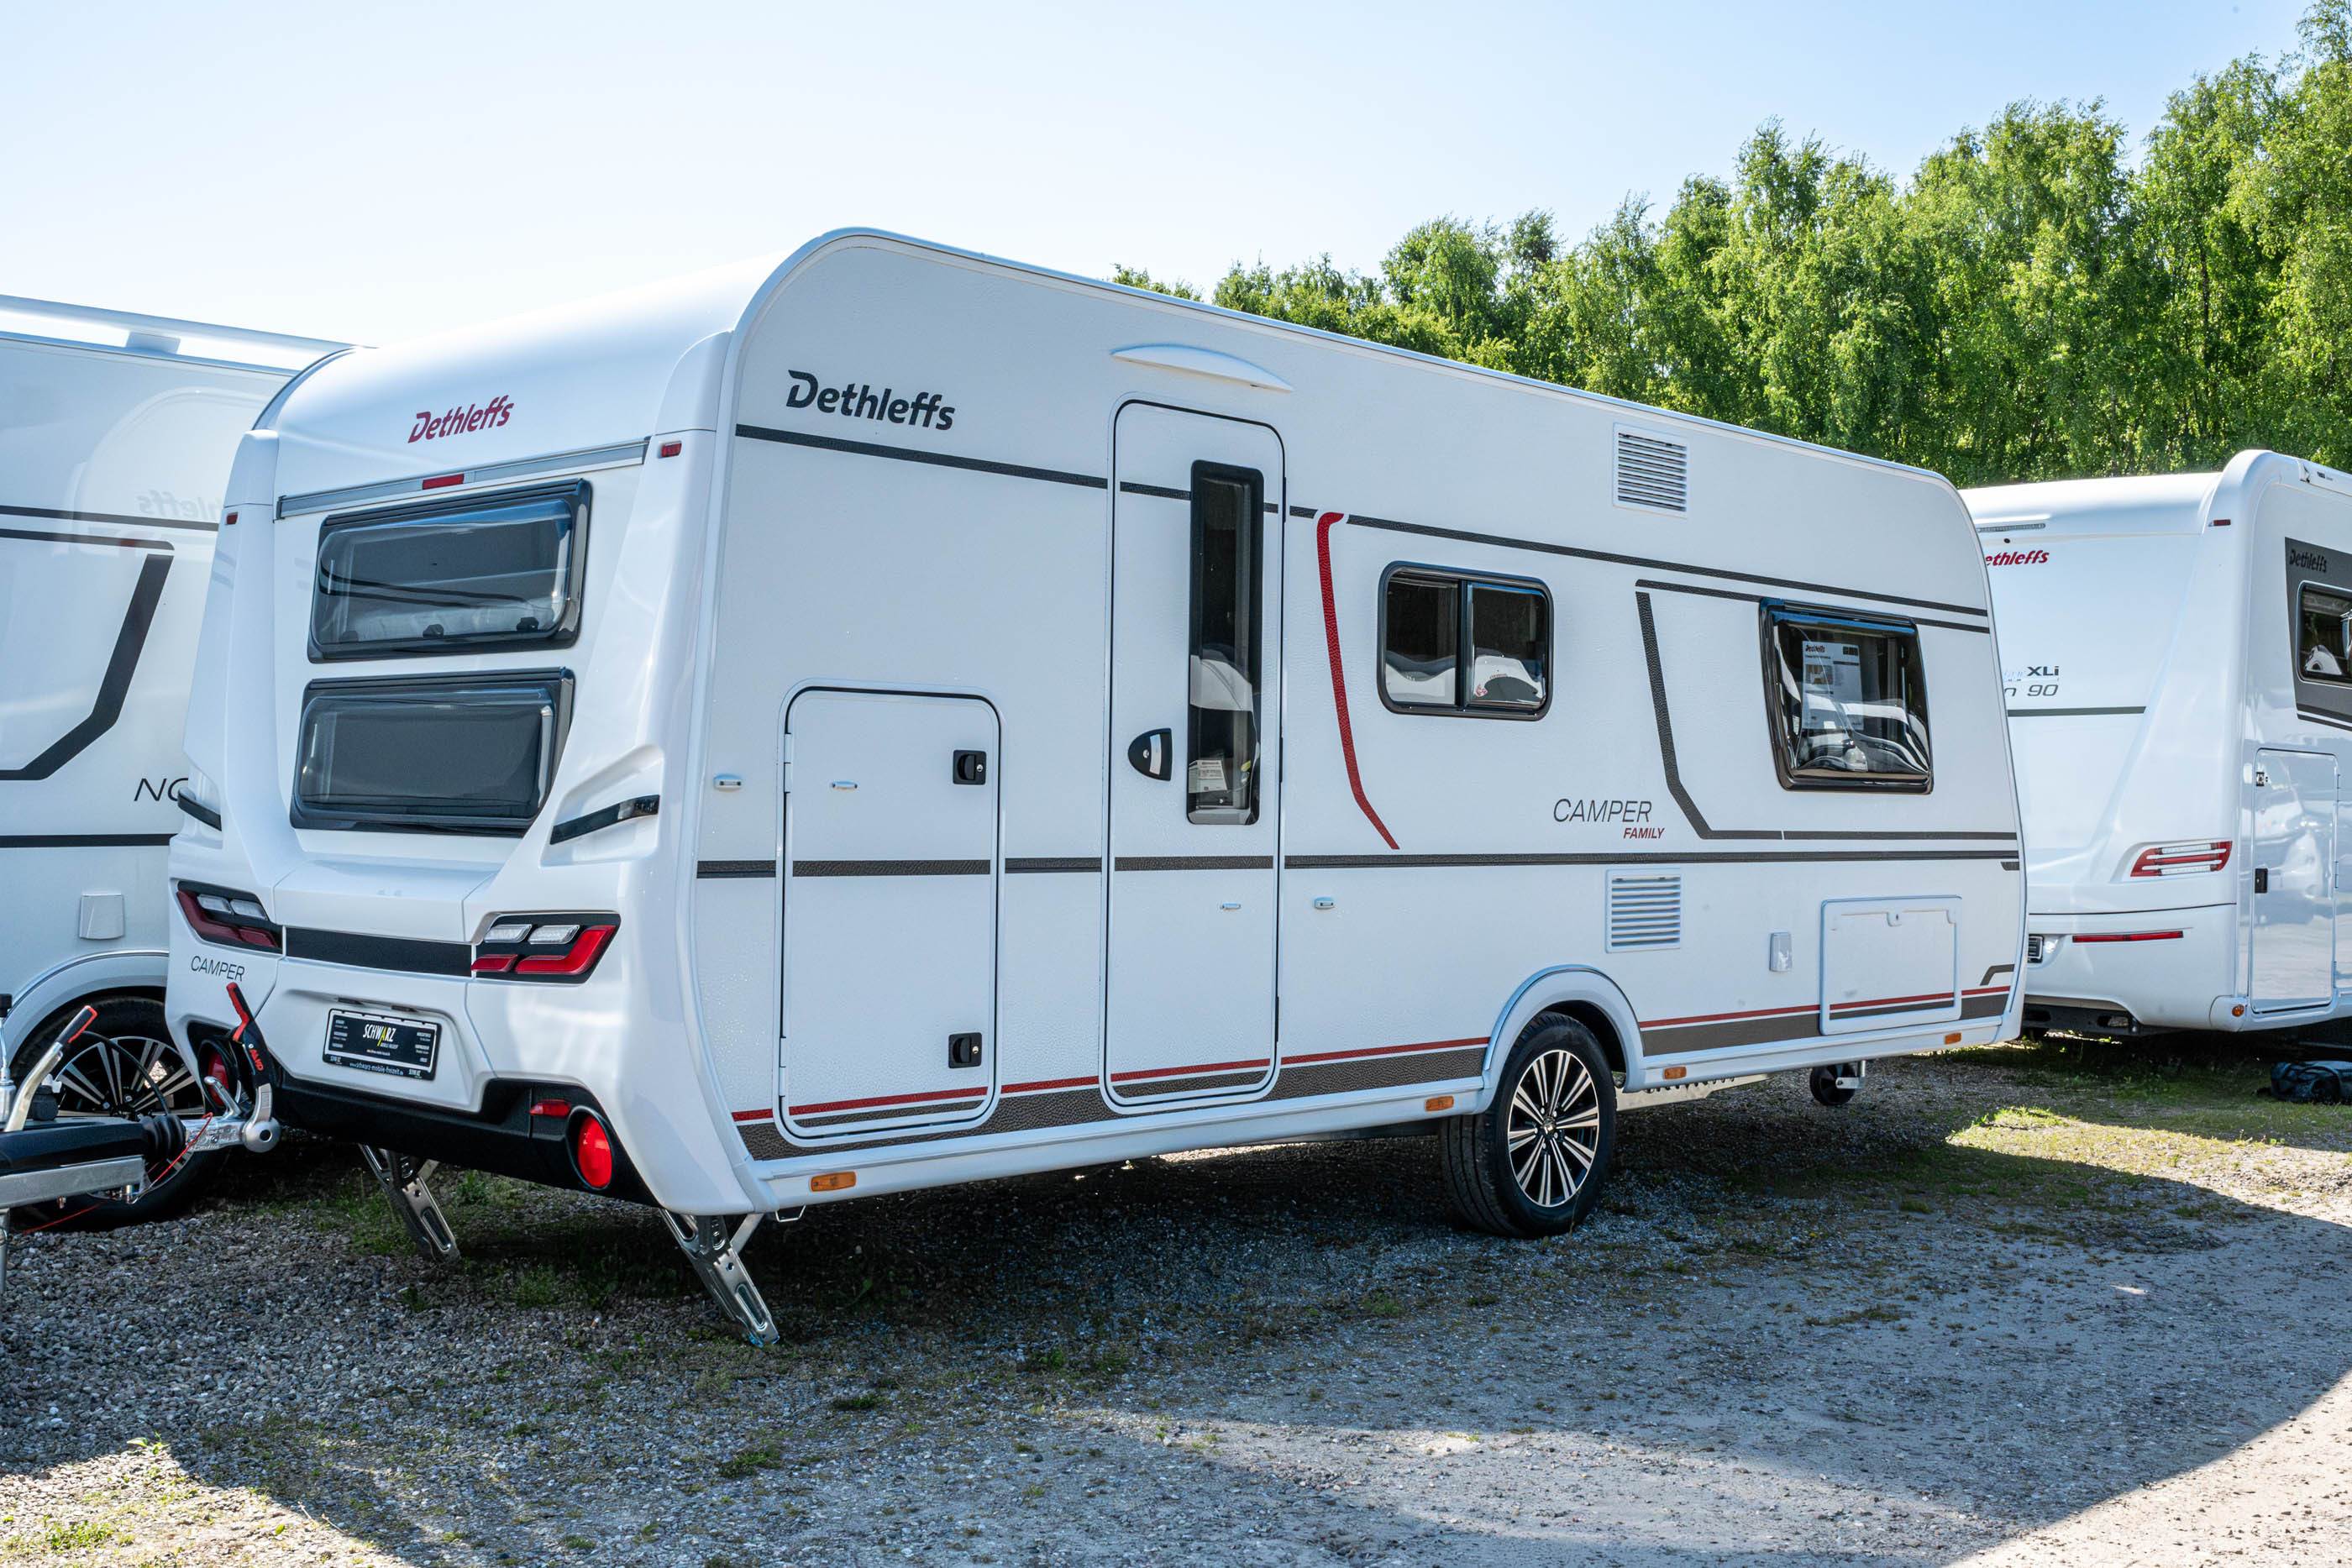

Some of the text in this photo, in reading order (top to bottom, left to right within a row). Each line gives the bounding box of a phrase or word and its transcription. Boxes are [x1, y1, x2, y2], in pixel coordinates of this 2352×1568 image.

[785, 370, 956, 431] Dethleffs
[407, 395, 515, 443] Dethleffs
[1985, 550, 2050, 566] ethleffs
[2289, 548, 2327, 573] Dethleffs
[2026, 666, 2060, 677] XLi
[2026, 684, 2059, 697] 90
[1553, 799, 1652, 823] CAMPER
[1623, 827, 1665, 839] FAMILY
[190, 955, 245, 982] CAMPER
[362, 1024, 396, 1047] SCHWARZ
